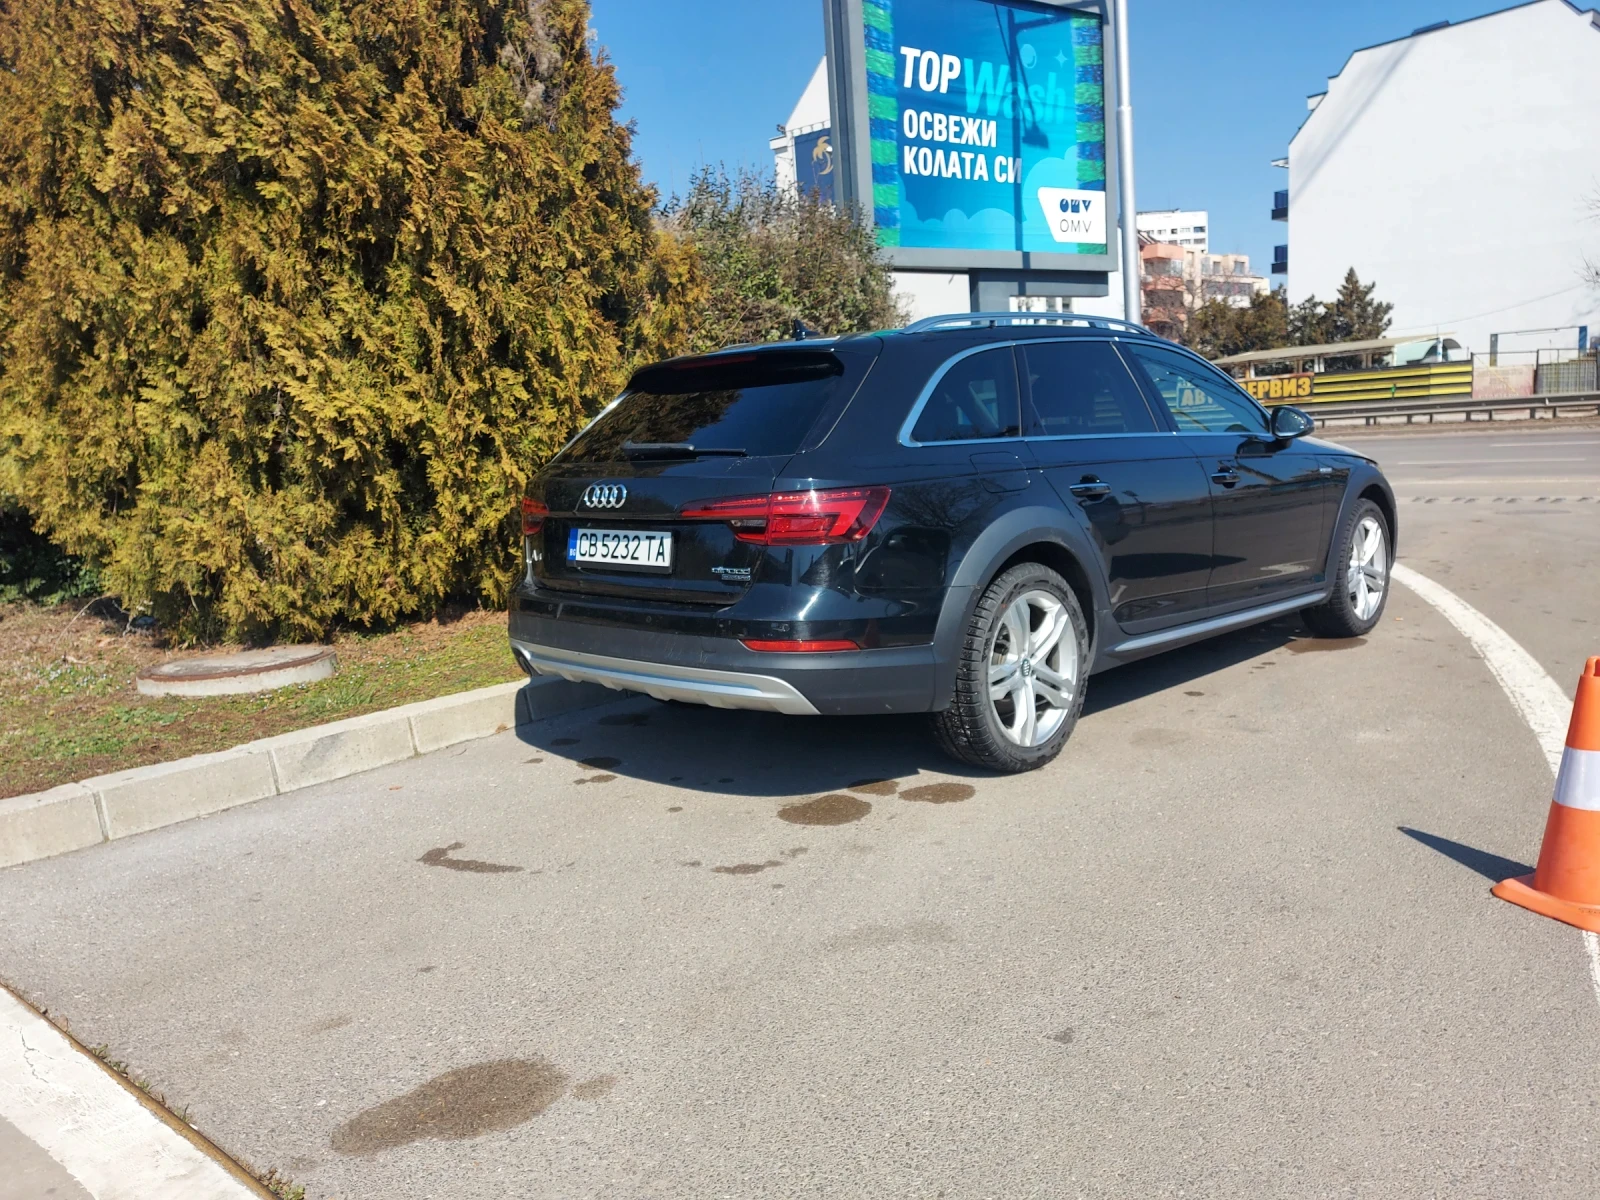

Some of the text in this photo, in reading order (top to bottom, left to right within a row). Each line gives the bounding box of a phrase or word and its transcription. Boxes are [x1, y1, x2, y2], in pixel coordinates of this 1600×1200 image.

[903, 109, 997, 147] ОСВЕЖИ
[903, 146, 1022, 183] КОЛАТА СИ
[1060, 218, 1092, 233] OMV
